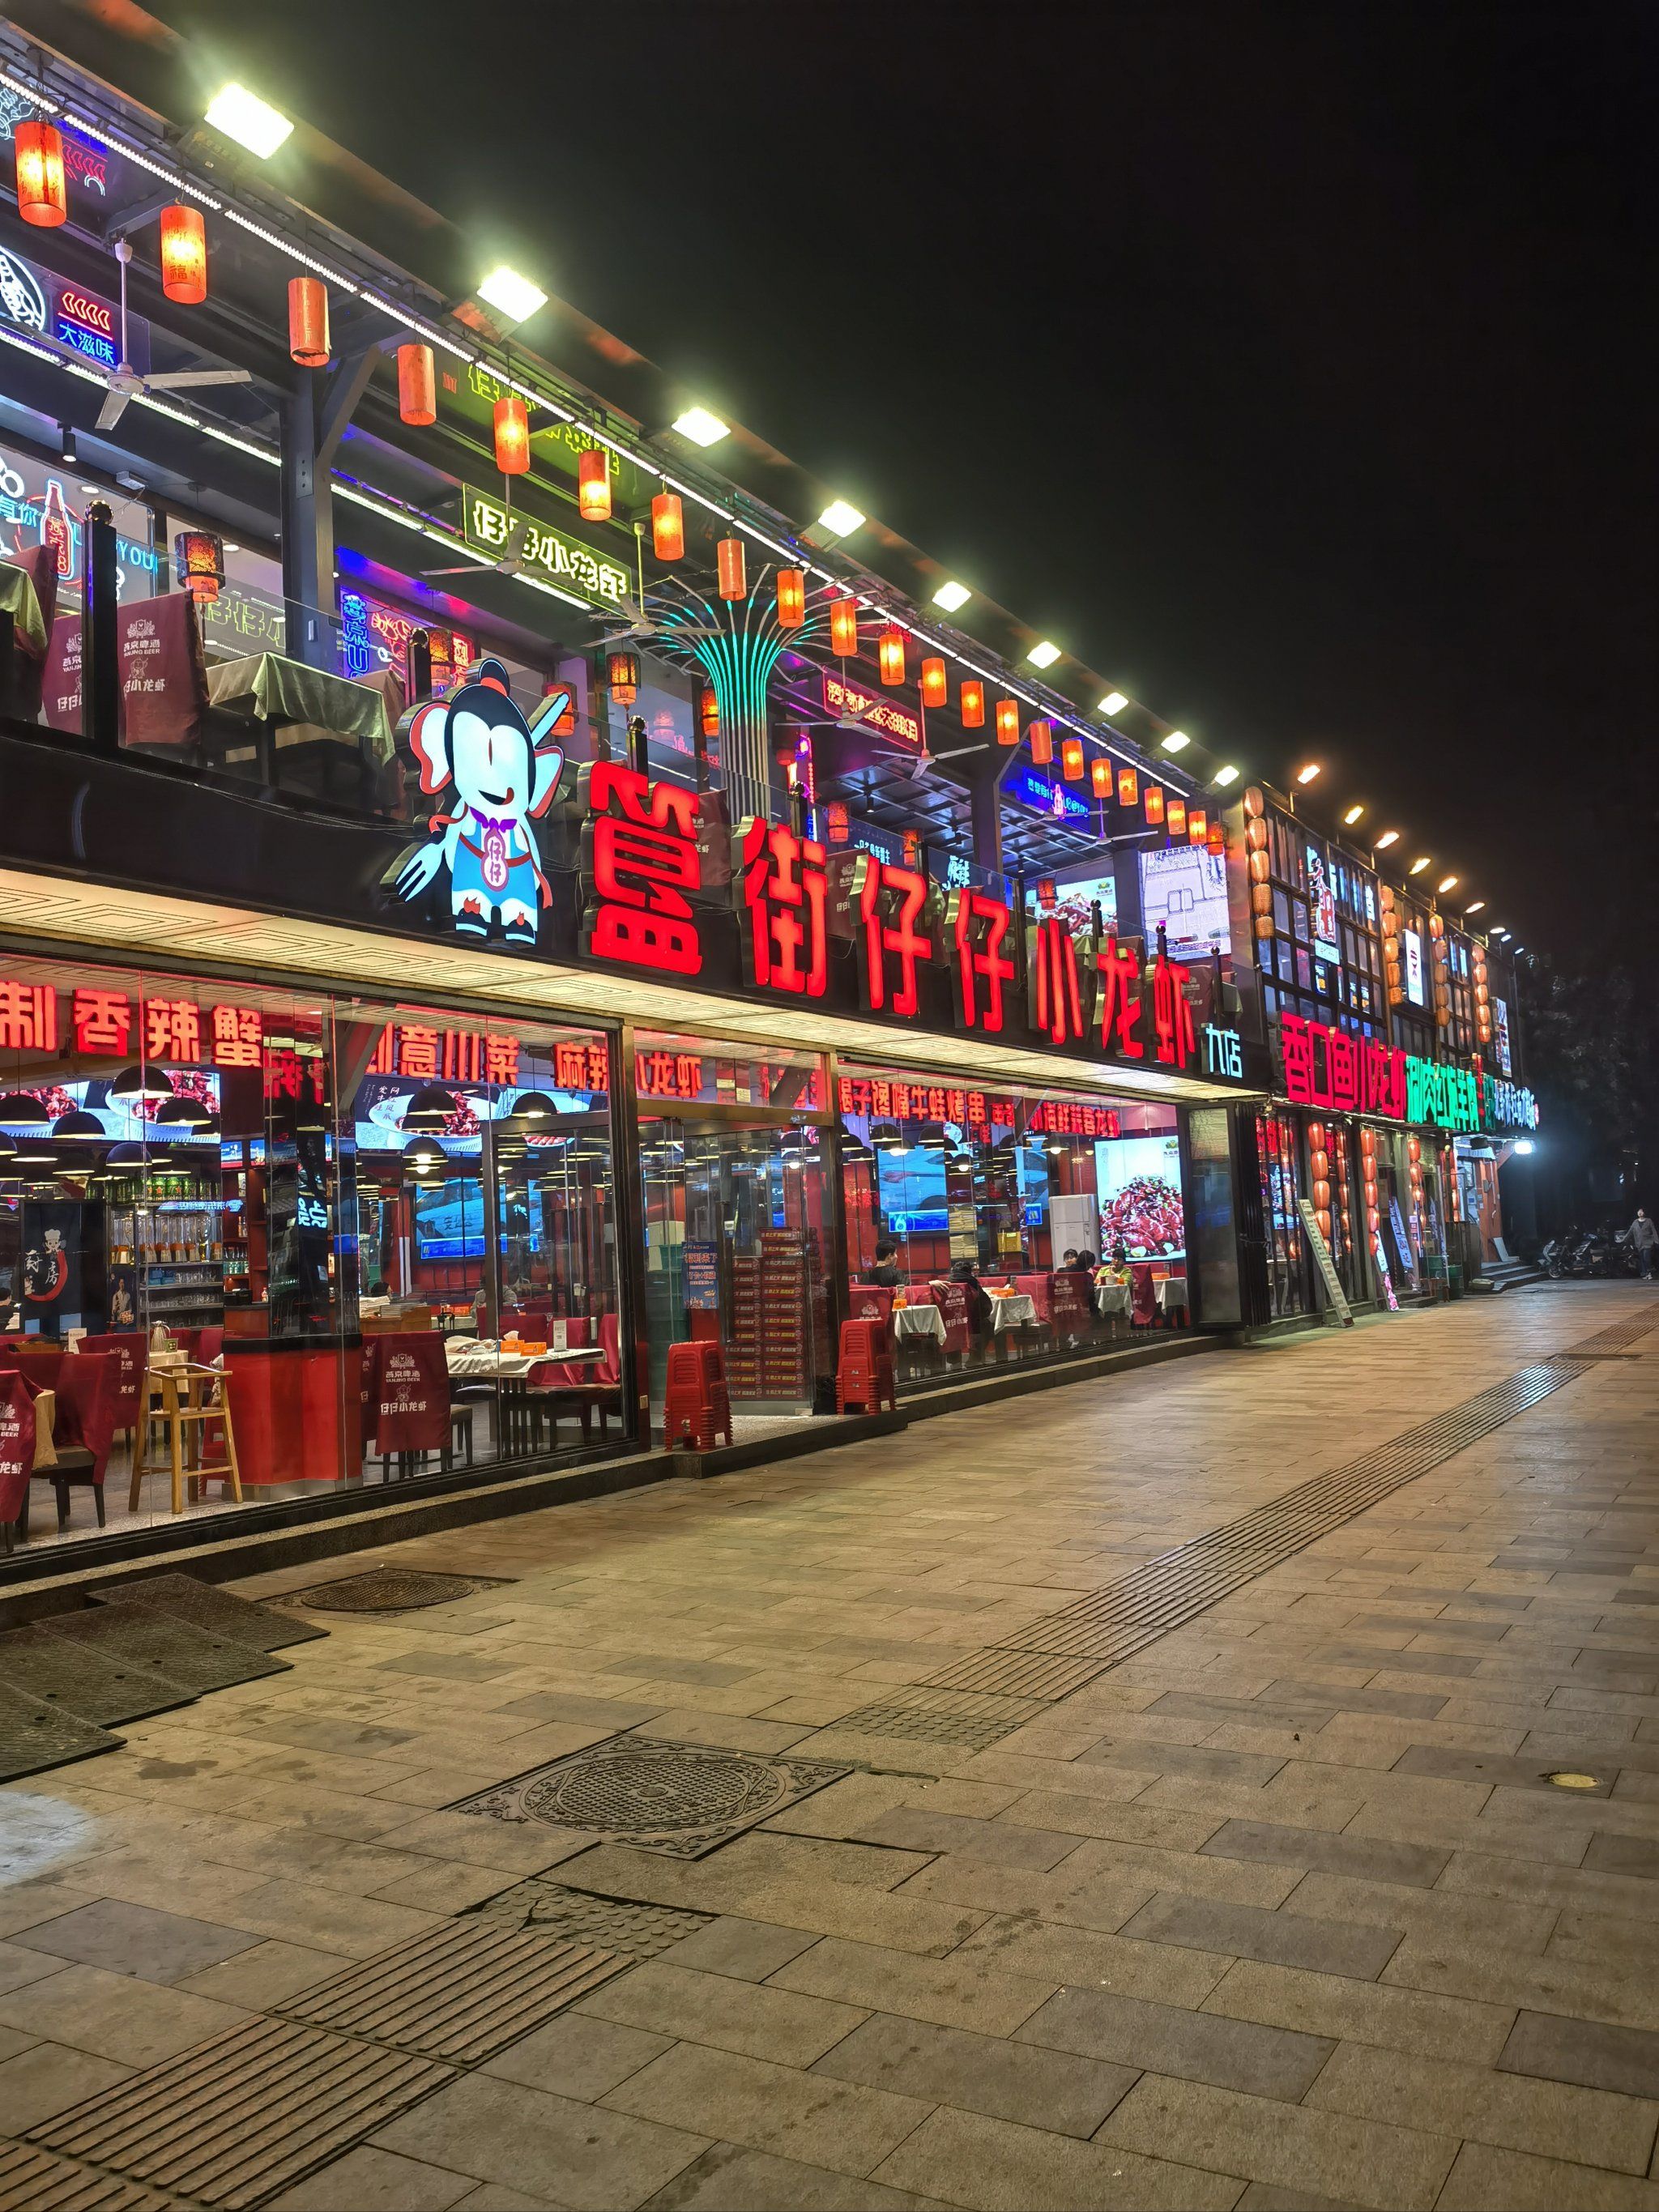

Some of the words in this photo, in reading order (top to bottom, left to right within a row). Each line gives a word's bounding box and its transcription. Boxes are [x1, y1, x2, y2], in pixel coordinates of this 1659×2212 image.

[58, 322, 115, 364] 大滋味
[488, 839, 502, 883] 仔仔
[0, 981, 262, 1068] 制香辣蟹
[381, 1400, 427, 1416] 仔仔小龙虾
